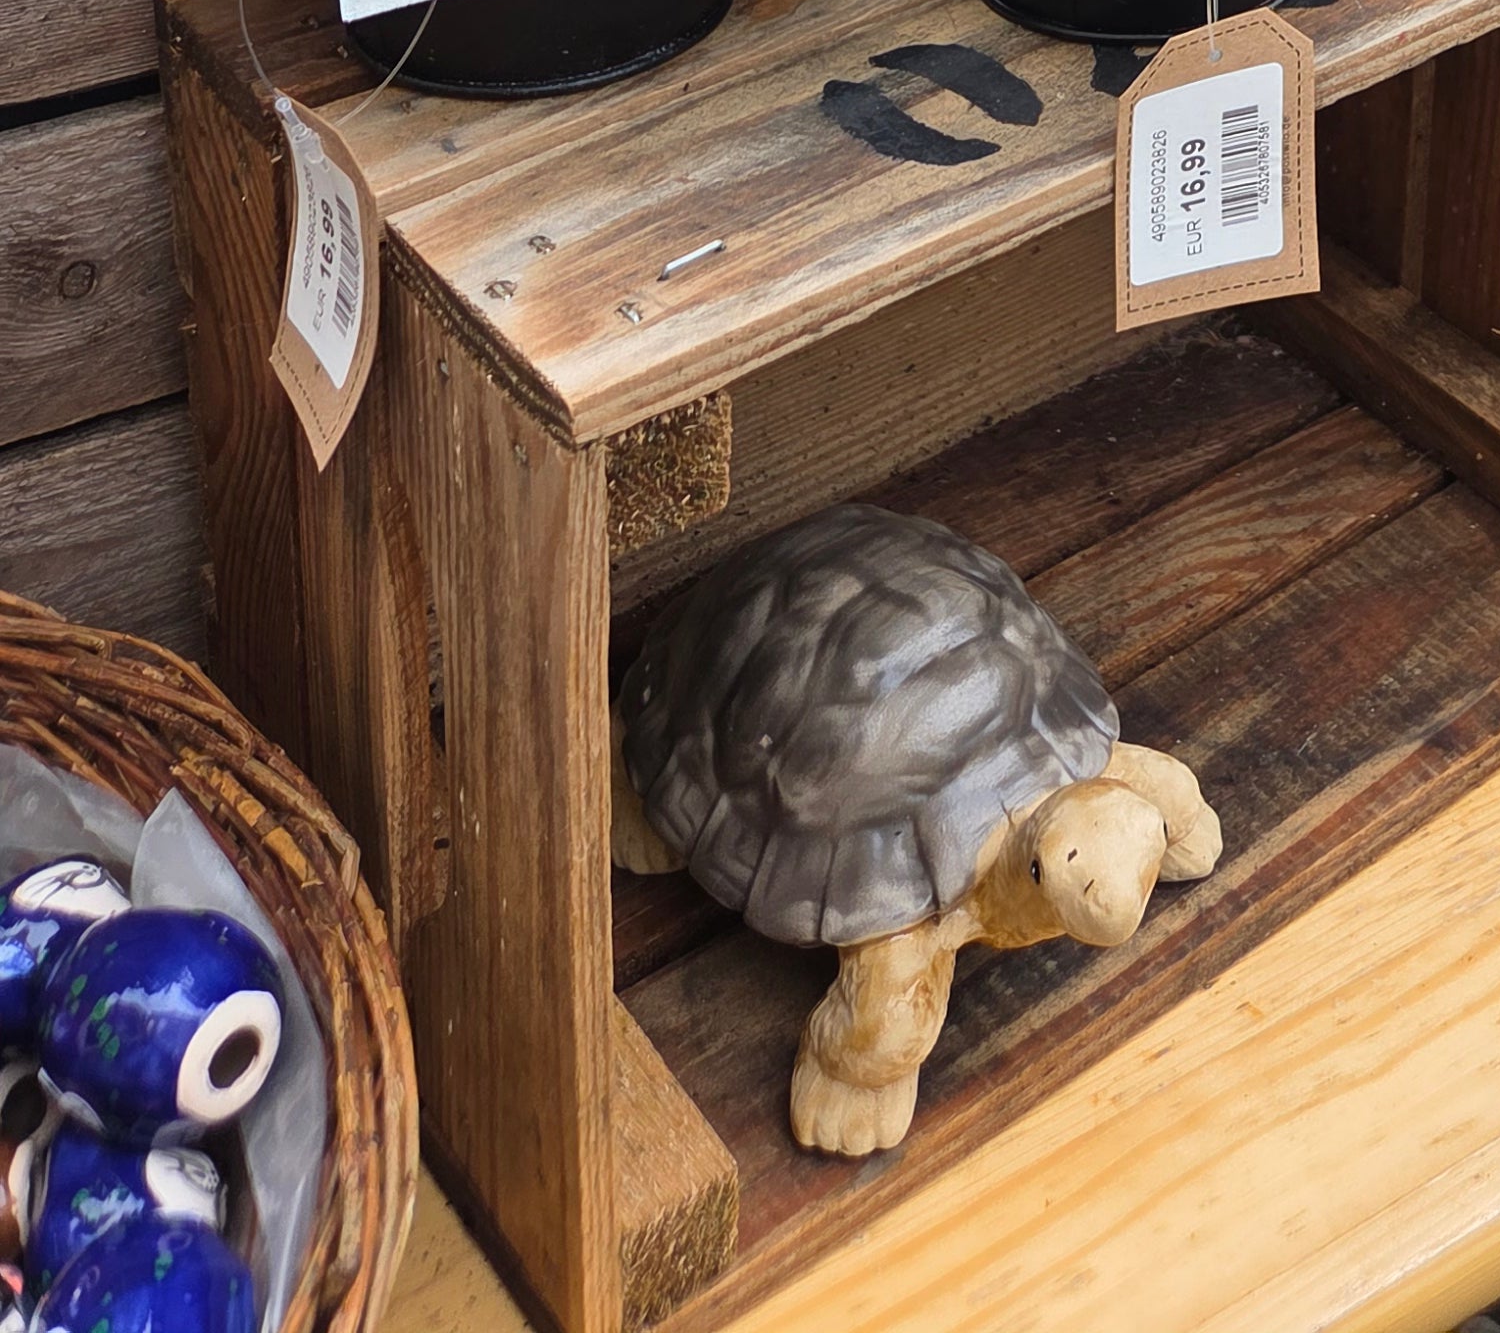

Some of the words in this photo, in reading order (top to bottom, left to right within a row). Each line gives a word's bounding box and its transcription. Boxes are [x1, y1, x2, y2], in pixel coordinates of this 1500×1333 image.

[1151, 129, 1168, 242] 490589023826
[1180, 137, 1212, 214] 16,99
[319, 198, 337, 280] 16,99
[1187, 219, 1203, 256] EUR
[312, 287, 328, 332] EUR
